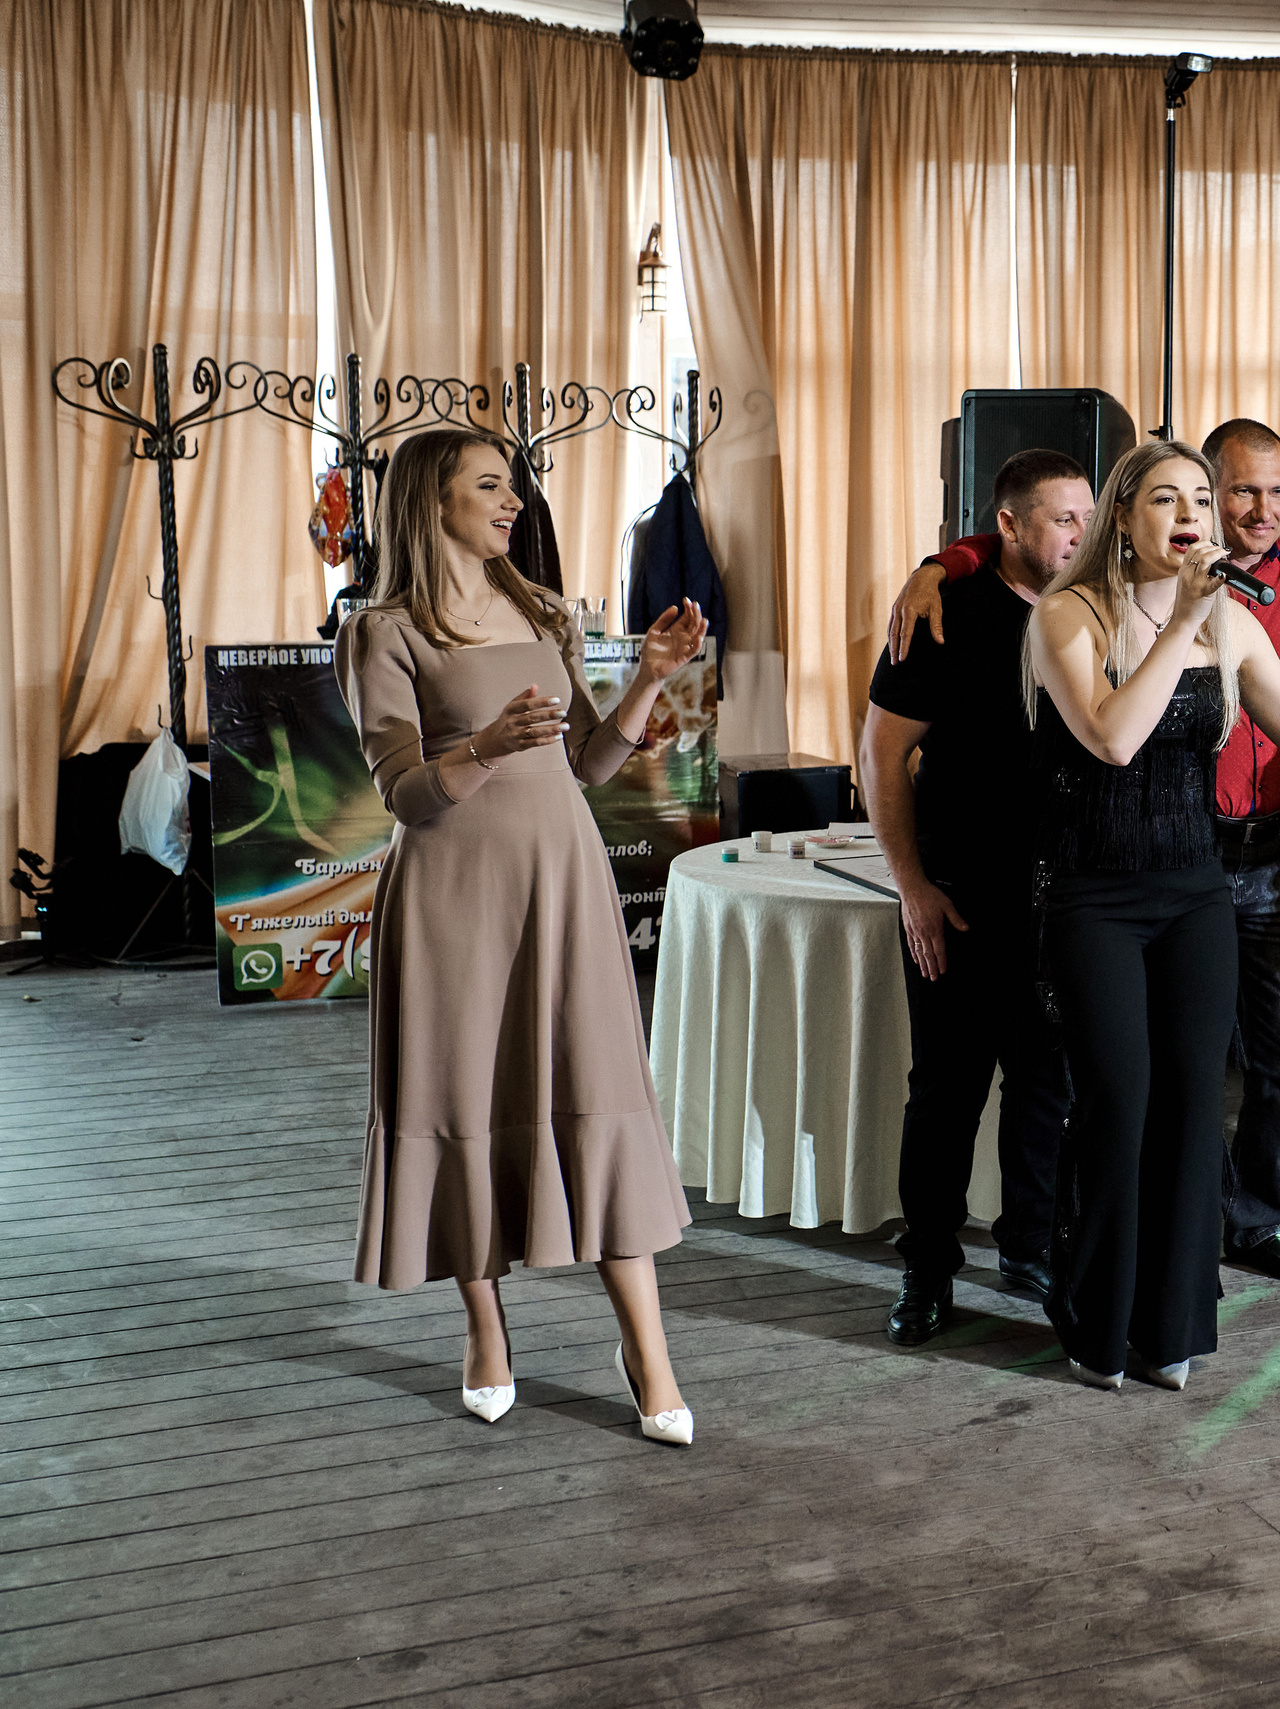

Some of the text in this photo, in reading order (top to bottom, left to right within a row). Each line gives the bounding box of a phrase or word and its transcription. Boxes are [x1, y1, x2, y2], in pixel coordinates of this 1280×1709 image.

[217, 647, 335, 667] НЕВЕРНОЕ УПО
[229, 908, 335, 932] Тяжелый
[627, 916, 663, 950] 4
